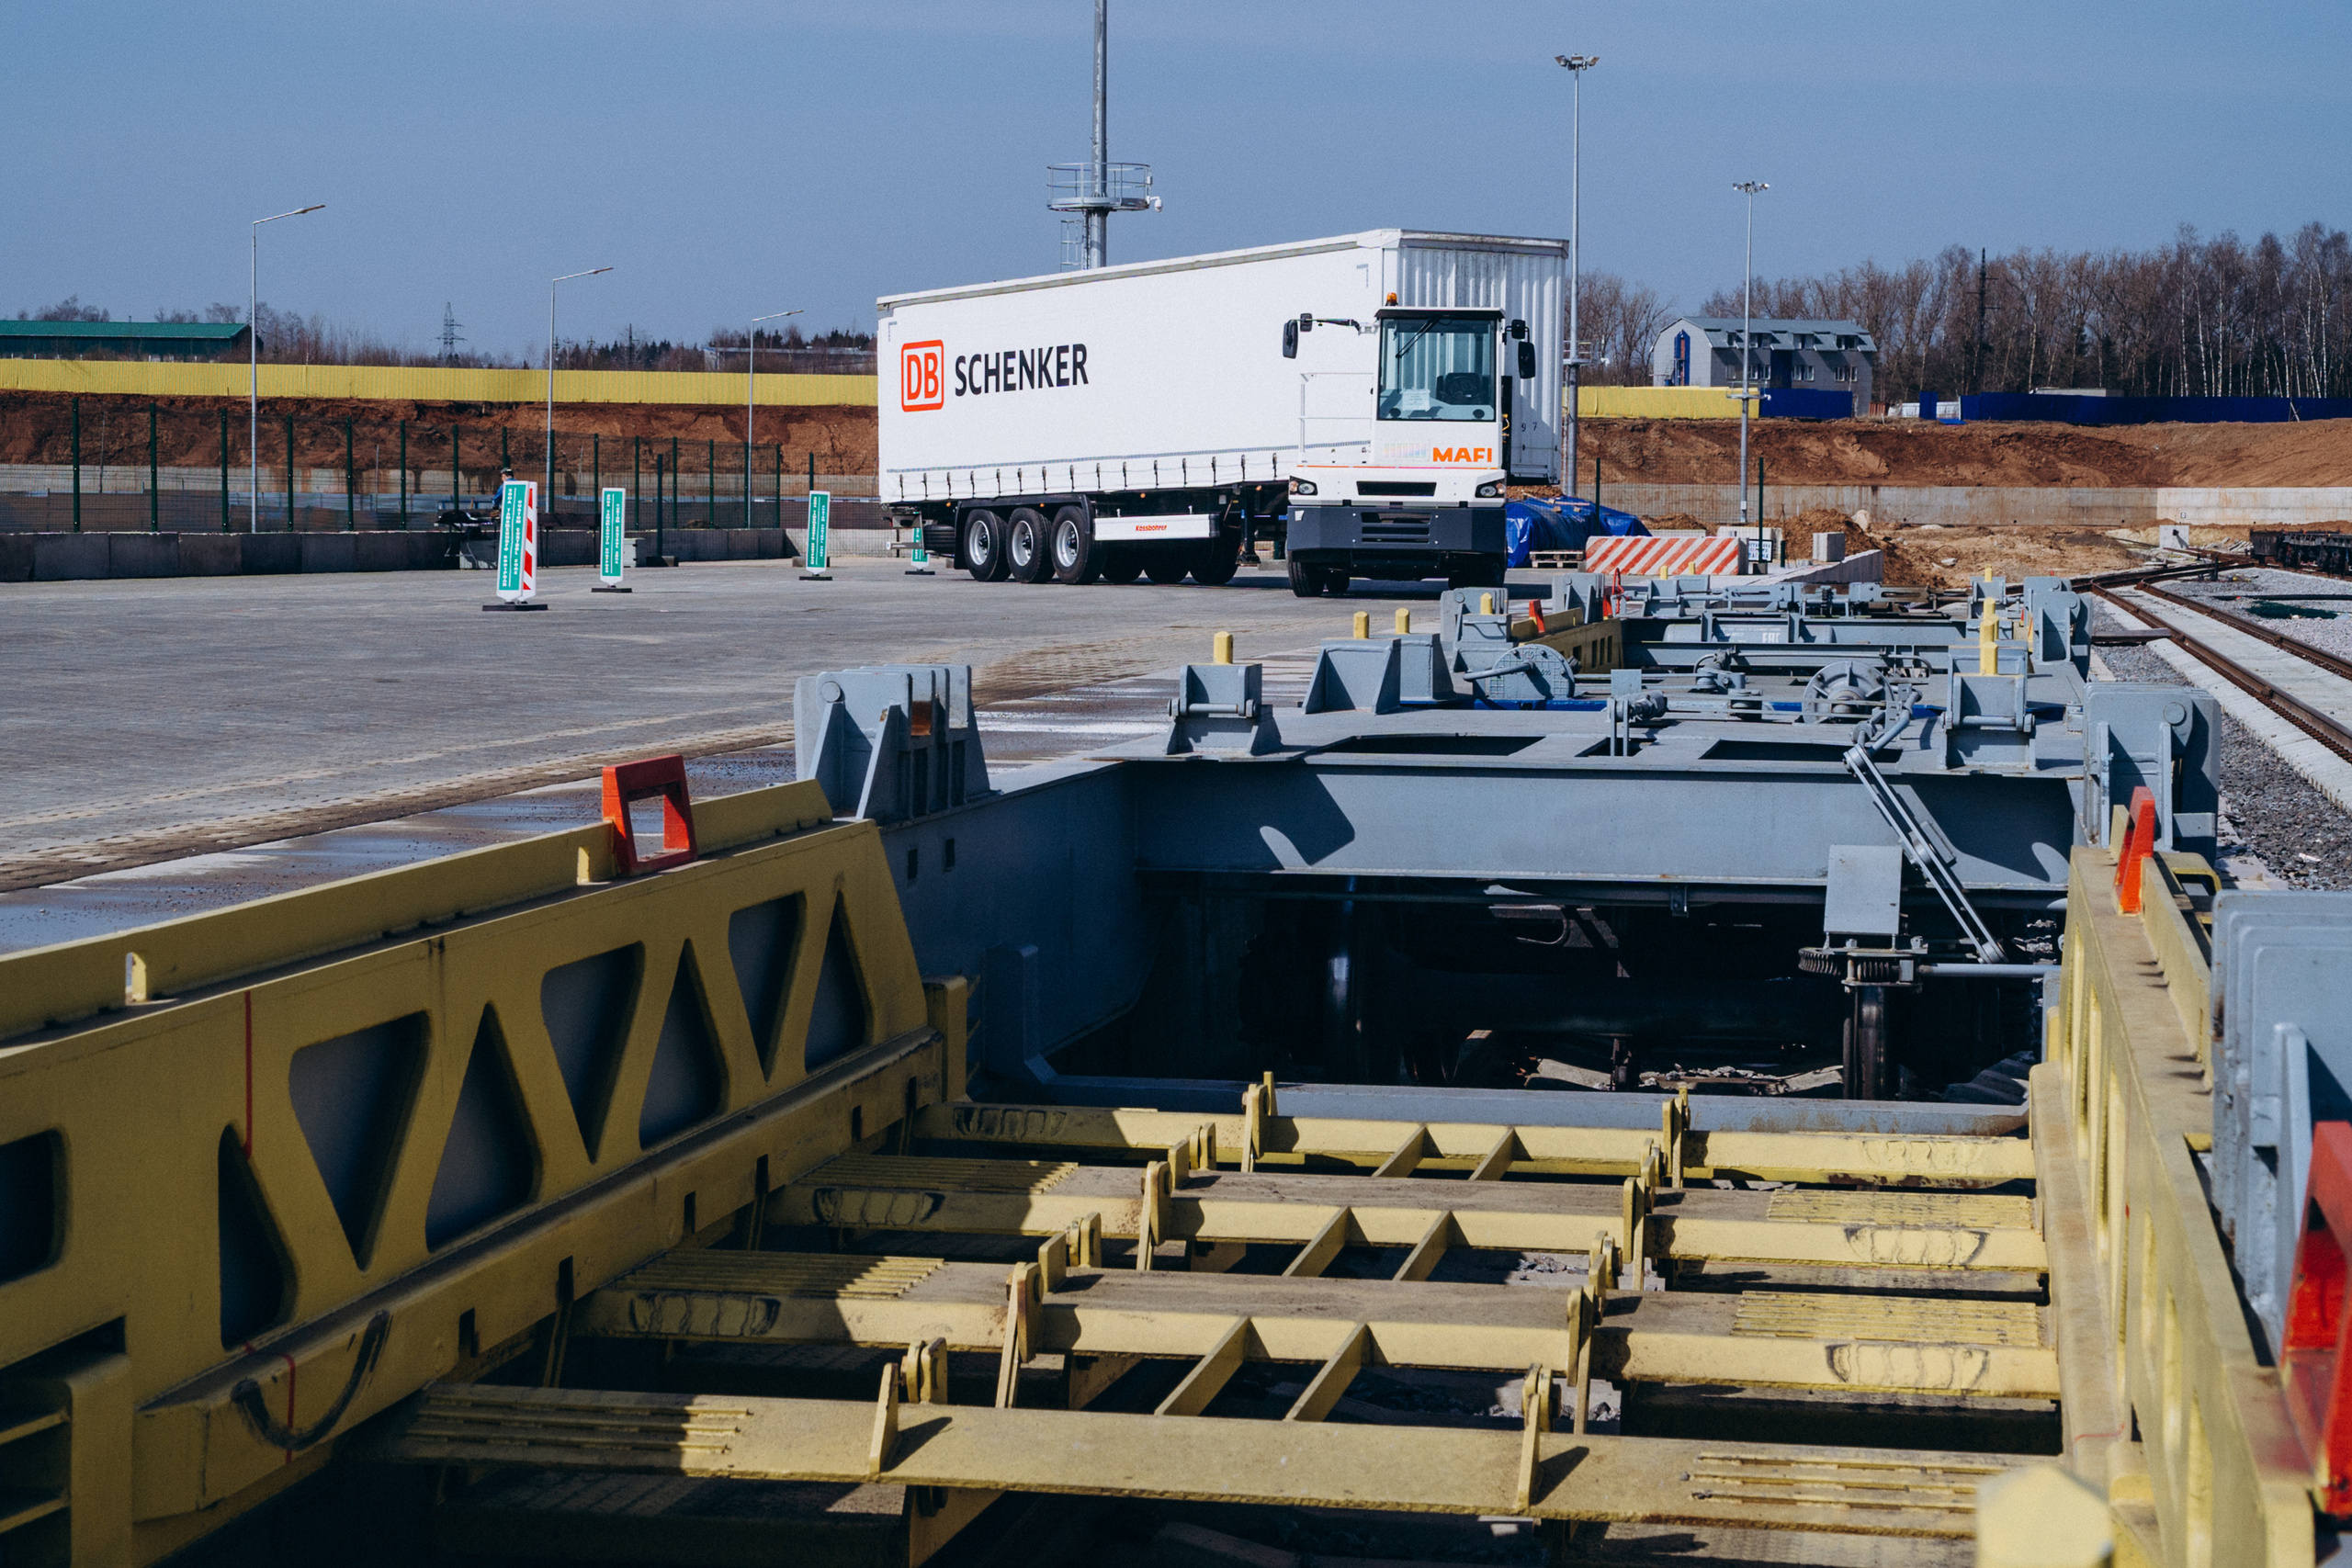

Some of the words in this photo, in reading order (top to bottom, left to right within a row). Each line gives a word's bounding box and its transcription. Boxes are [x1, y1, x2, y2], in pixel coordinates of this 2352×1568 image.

[907, 352, 939, 400] DB
[955, 343, 1089, 397] SCHENKER
[1432, 447, 1492, 463] MAFI
